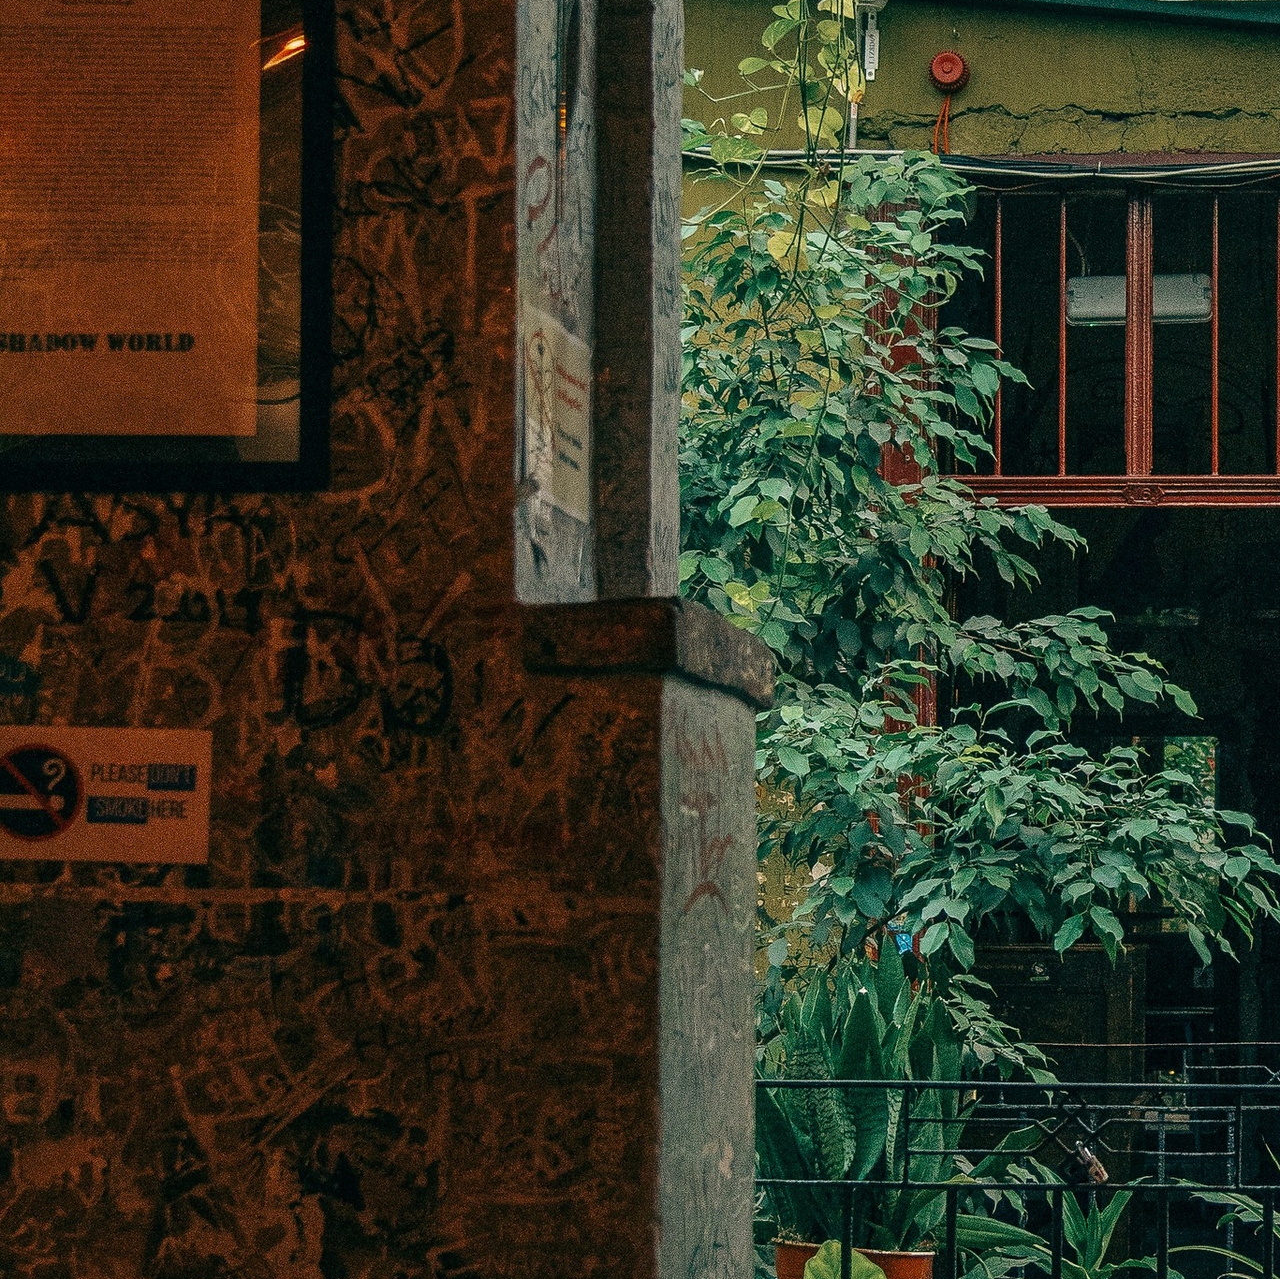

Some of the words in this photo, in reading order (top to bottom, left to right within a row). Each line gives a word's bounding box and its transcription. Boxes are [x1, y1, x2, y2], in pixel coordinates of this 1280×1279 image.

[106, 332, 196, 353] WORLD
[92, 764, 148, 784] PLEASE
[149, 766, 195, 785] DON'T
[95, 799, 148, 819] SMOKE
[149, 800, 188, 819] HERE
